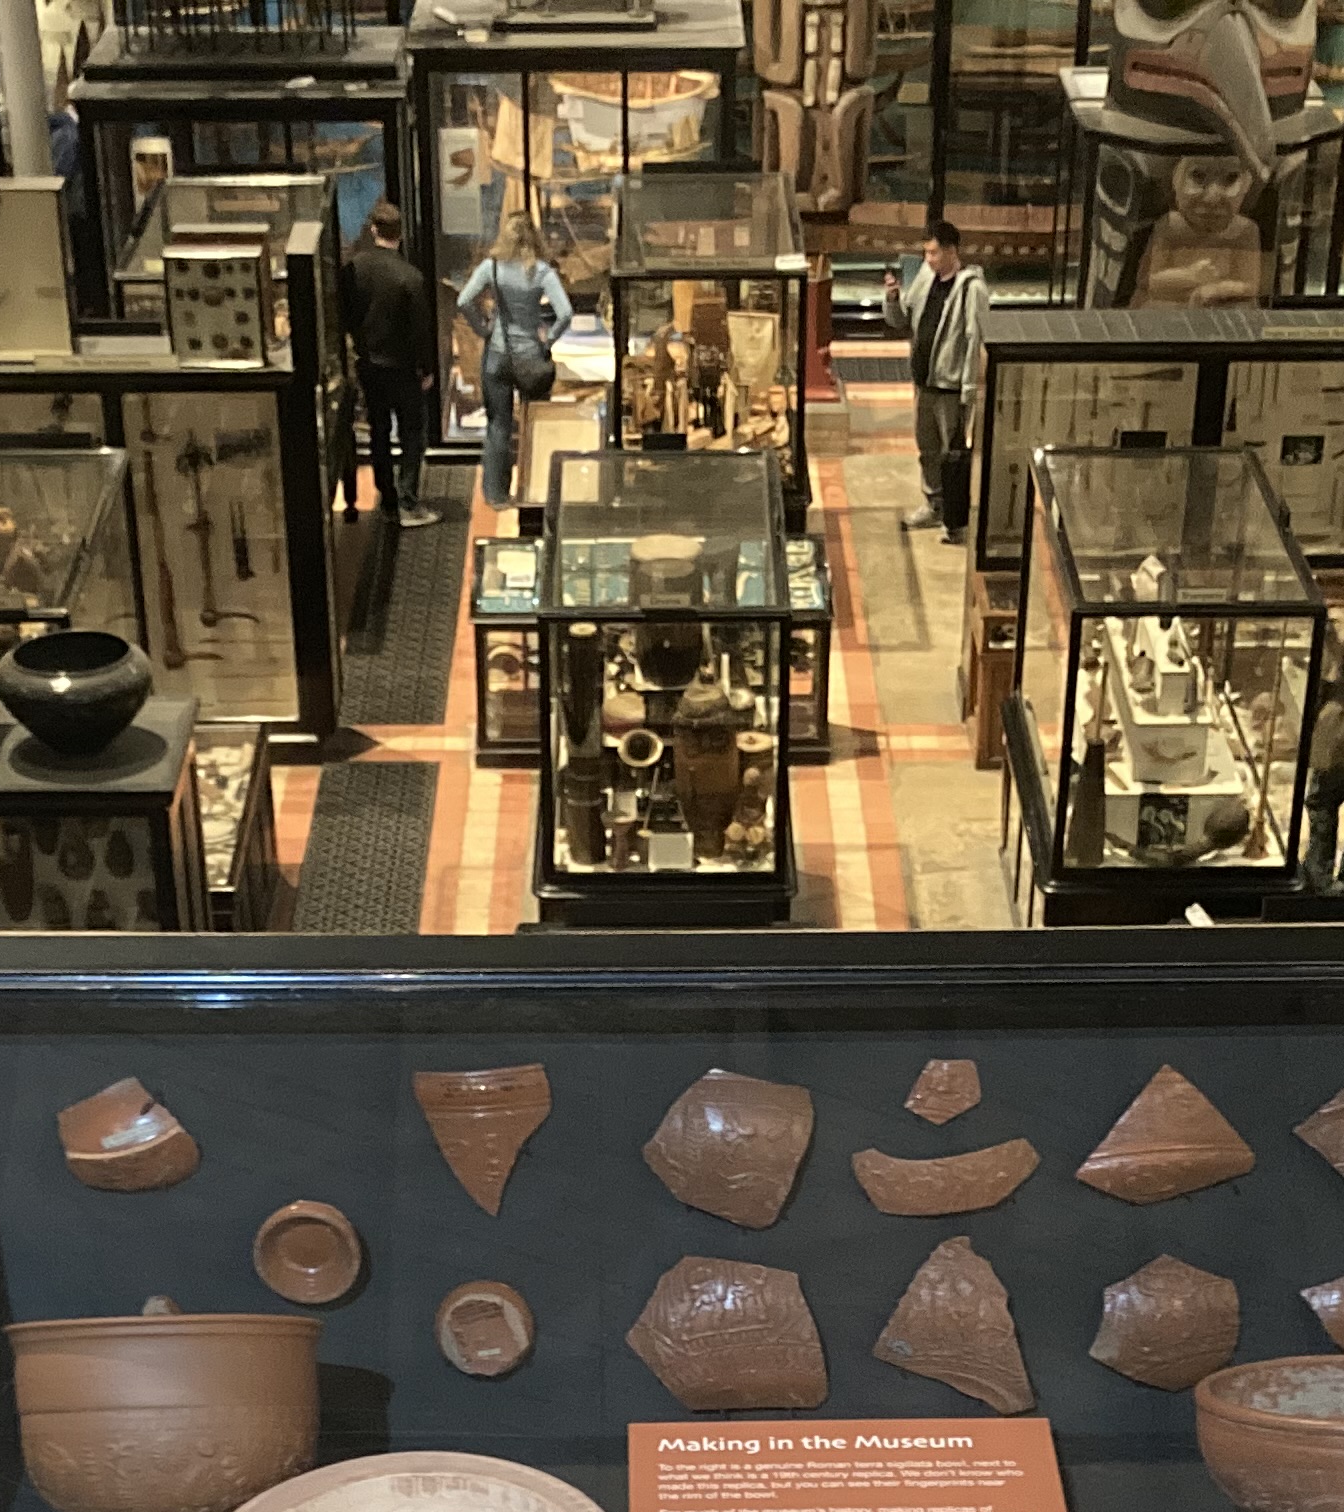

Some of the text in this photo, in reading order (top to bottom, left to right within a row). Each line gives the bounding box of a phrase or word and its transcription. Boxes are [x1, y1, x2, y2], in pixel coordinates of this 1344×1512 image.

[658, 1435, 972, 1453] Making in the Museum
